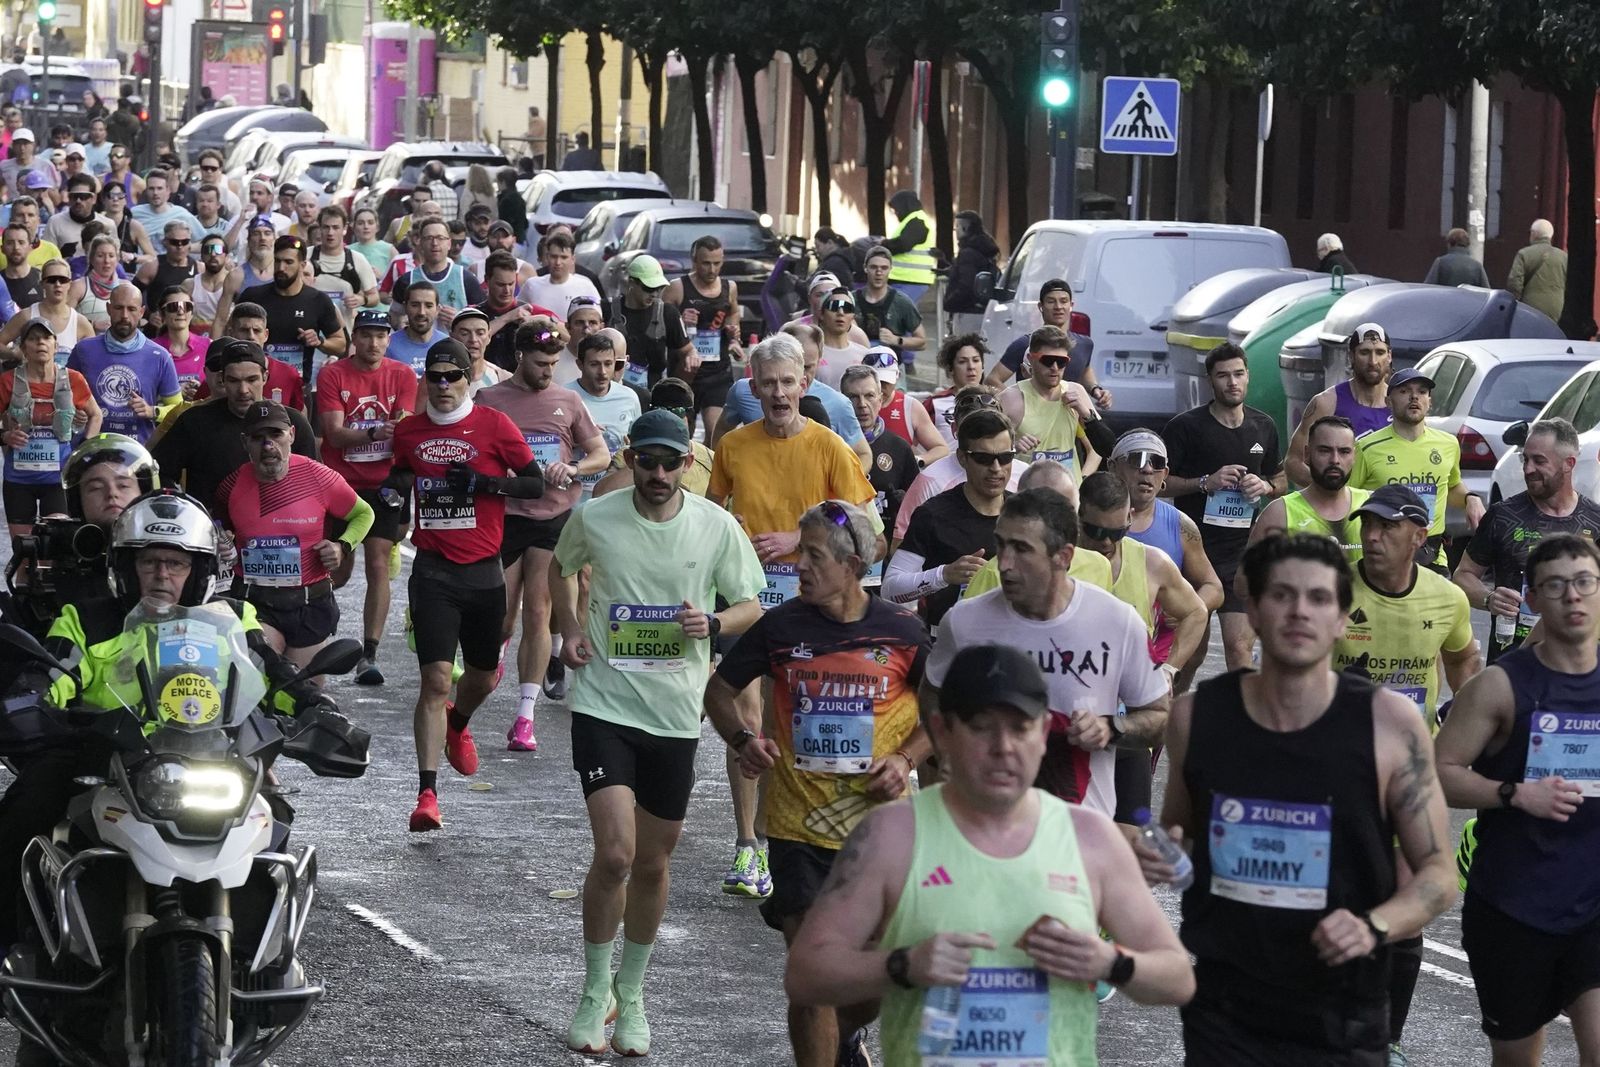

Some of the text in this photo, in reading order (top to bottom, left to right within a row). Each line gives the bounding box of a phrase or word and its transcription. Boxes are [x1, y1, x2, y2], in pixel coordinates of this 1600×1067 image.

[1113, 363, 1170, 375] 9177 MFY
[260, 407, 269, 416] B
[421, 440, 436, 450] BANK
[445, 439, 470, 450] AMERICA
[427, 446, 462, 455] CHICAGO
[18, 452, 55, 461] MICHELE
[419, 507, 475, 519] LUCIA Y JAVI
[1218, 506, 1244, 517] HUGO
[150, 525, 181, 534] HJC
[244, 560, 300, 575] ESPIÑEIRA
[763, 564, 793, 572] URICH
[759, 592, 784, 604] ETER
[636, 629, 659, 638] 2720
[185, 646, 195, 660] 8
[615, 642, 680, 657] ILLESCAS
[176, 677, 206, 688] MOTO
[796, 670, 879, 685] Club Deportivo
[1370, 672, 1428, 686] RAFLORES
[171, 687, 212, 699] ENLACE
[162, 702, 179, 719] COTA
[204, 703, 220, 720] CERO
[818, 701, 864, 711] ZURICH
[818, 724, 843, 734] 6885
[803, 738, 860, 754] CARLOS
[1563, 744, 1588, 754] 7807
[1251, 807, 1316, 825] ZURICH
[1231, 857, 1304, 883] JIMMY
[967, 971, 1036, 988] ZURICH
